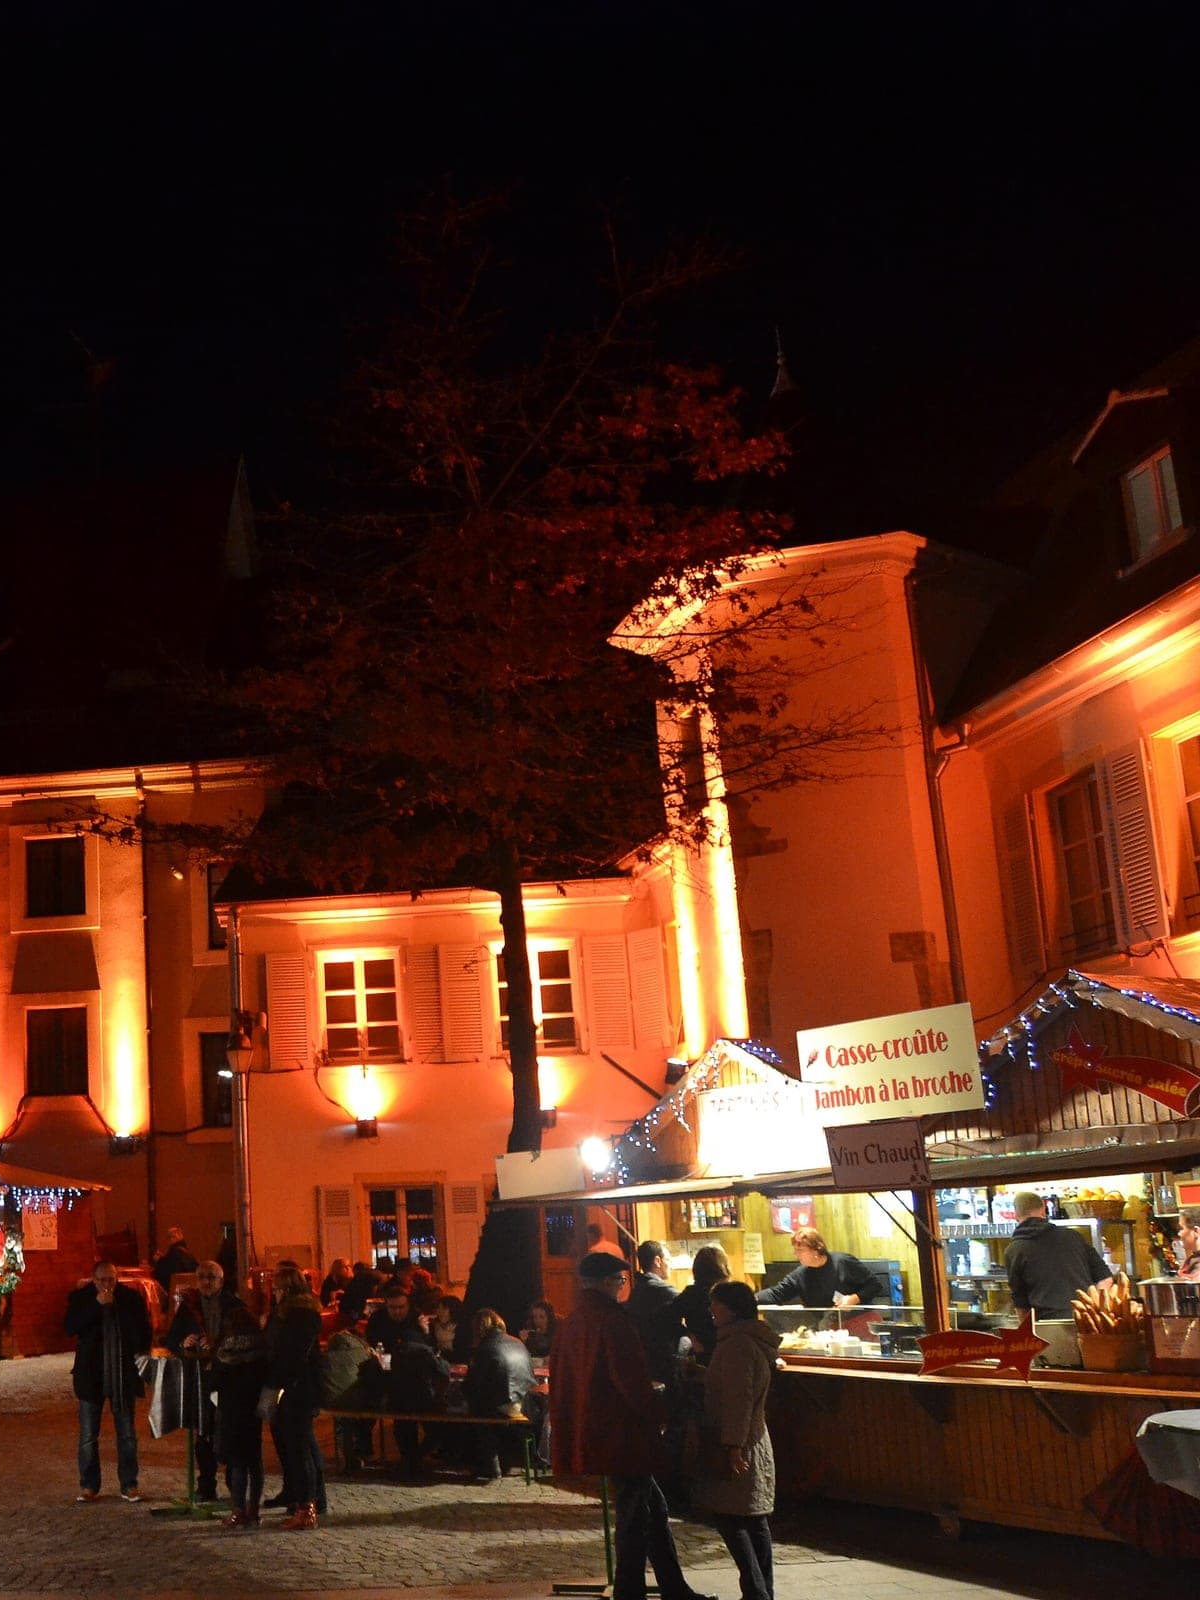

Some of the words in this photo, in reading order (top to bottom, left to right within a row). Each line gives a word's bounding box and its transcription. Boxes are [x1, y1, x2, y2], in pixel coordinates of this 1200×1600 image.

[825, 1028, 949, 1068] Casse-croûte
[815, 1084, 876, 1110] Jambon
[879, 1079, 890, 1102] à
[893, 1078, 909, 1101] la
[912, 1071, 973, 1098] broche
[1147, 1077, 1188, 1098] salée
[832, 1145, 860, 1167] Vin
[864, 1140, 921, 1165] Chaud
